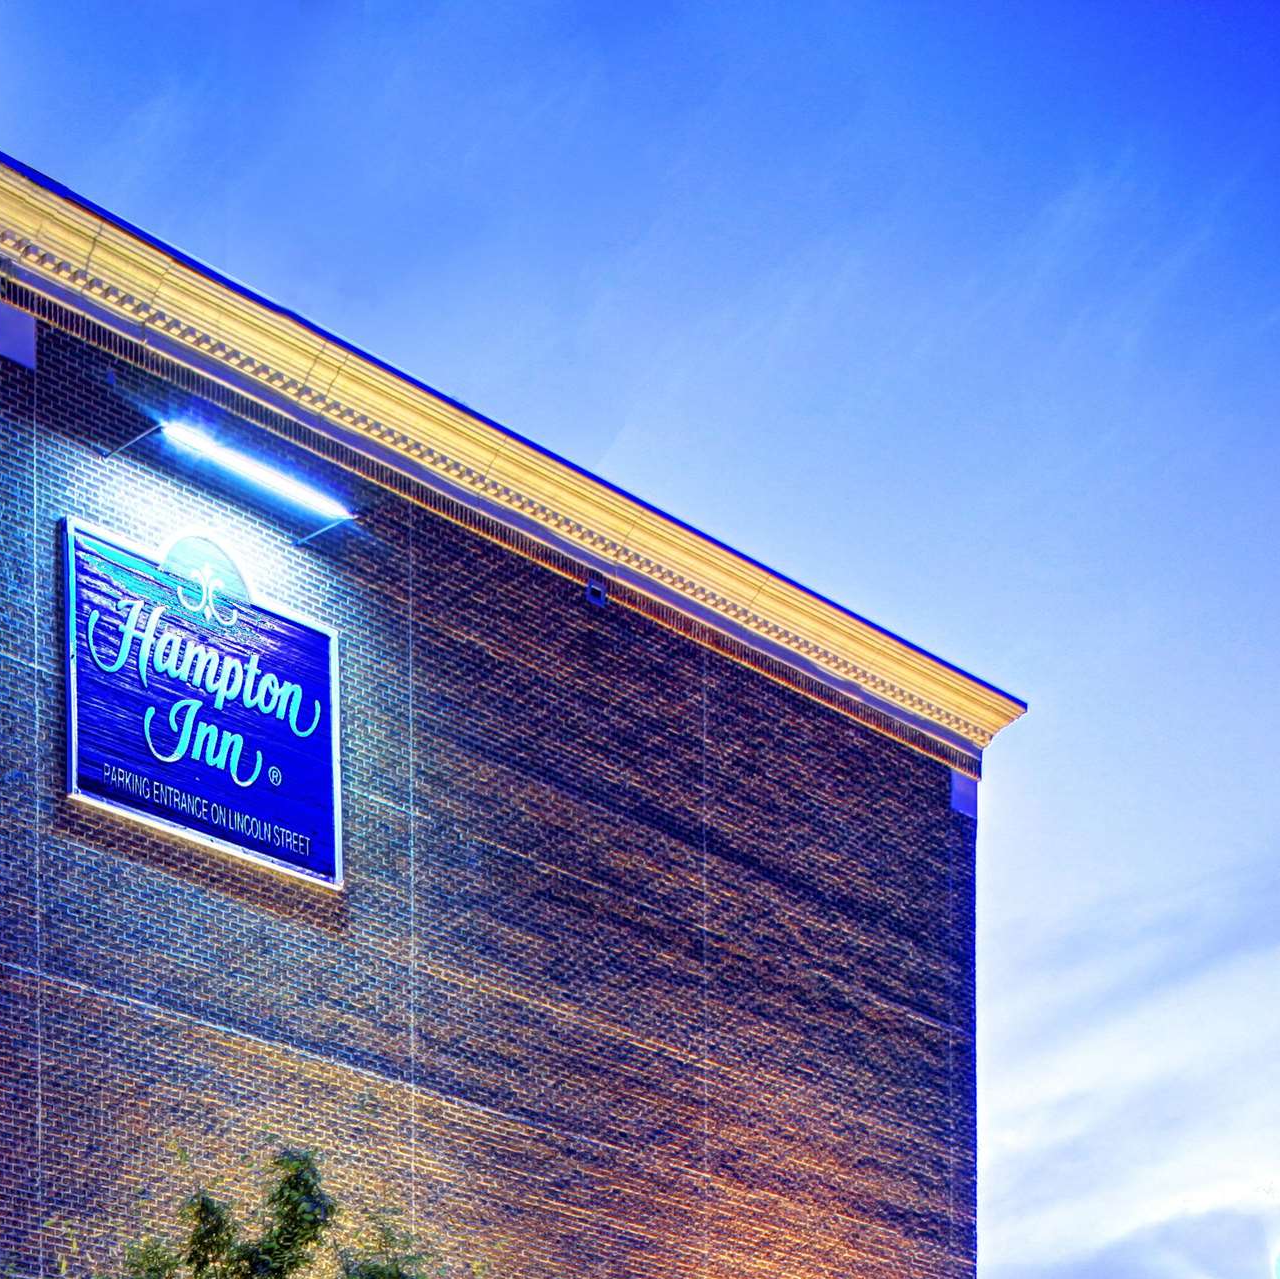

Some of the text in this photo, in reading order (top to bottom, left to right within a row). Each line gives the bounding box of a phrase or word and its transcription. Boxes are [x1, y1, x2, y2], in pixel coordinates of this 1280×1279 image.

[88, 599, 321, 737] Hampton
[144, 699, 263, 787] Inn
[103, 761, 311, 857] PARKING ENTRANCE ON LINCOLN STREET
